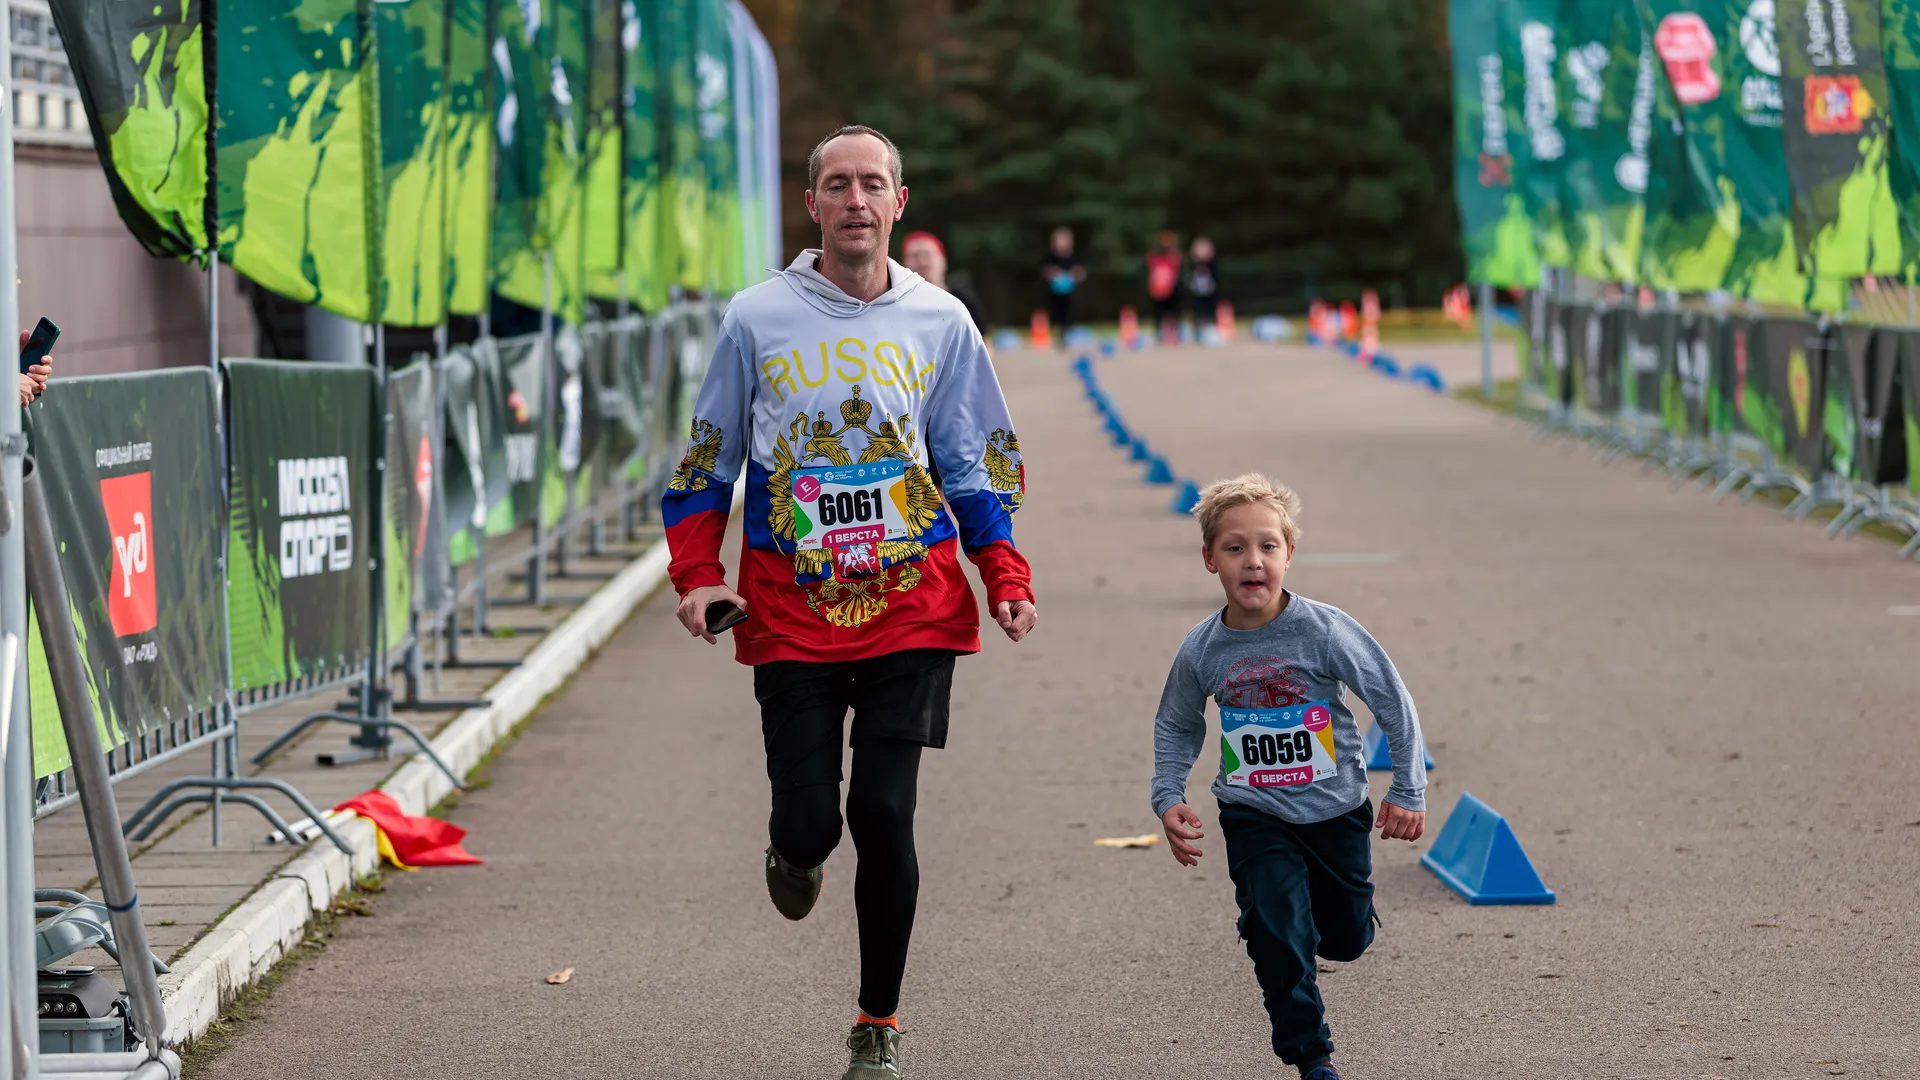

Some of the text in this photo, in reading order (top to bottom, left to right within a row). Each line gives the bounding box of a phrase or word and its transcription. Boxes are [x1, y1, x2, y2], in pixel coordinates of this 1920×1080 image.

[818, 488, 883, 526] 6061
[827, 535, 833, 544] 1
[835, 529, 880, 543] ВЕРСТА
[1241, 730, 1313, 766] 6059
[1253, 774, 1259, 783] 1
[1261, 771, 1308, 783] ВЕРСТА
